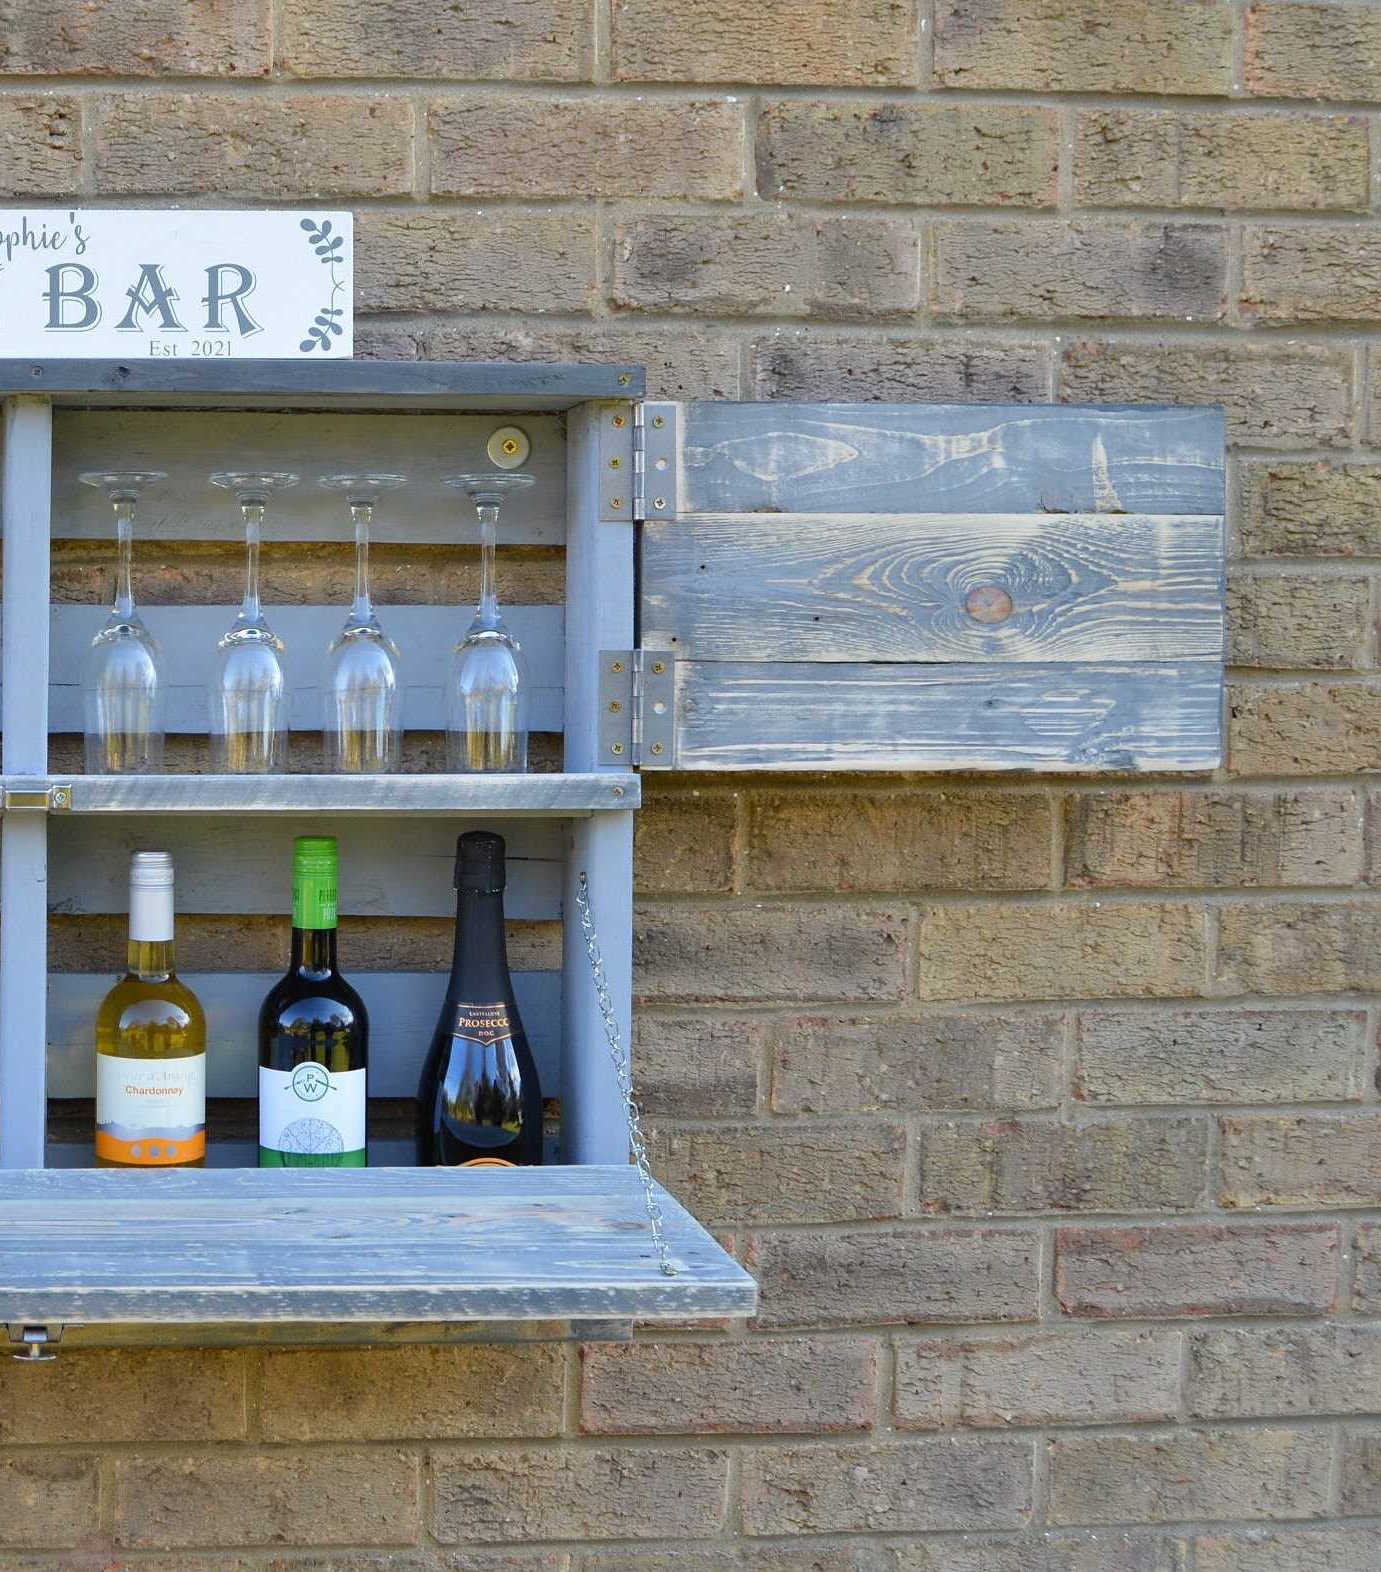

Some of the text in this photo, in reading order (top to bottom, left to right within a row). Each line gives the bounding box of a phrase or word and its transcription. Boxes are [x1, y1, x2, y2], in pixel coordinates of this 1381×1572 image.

[41, 262, 265, 340] BAR
[149, 340, 232, 357] Est 2021
[458, 1017, 511, 1028] PROSECCO
[306, 1074, 315, 1083] P
[125, 1085, 184, 1096] Chardonnay
[303, 1083, 318, 1093] W
